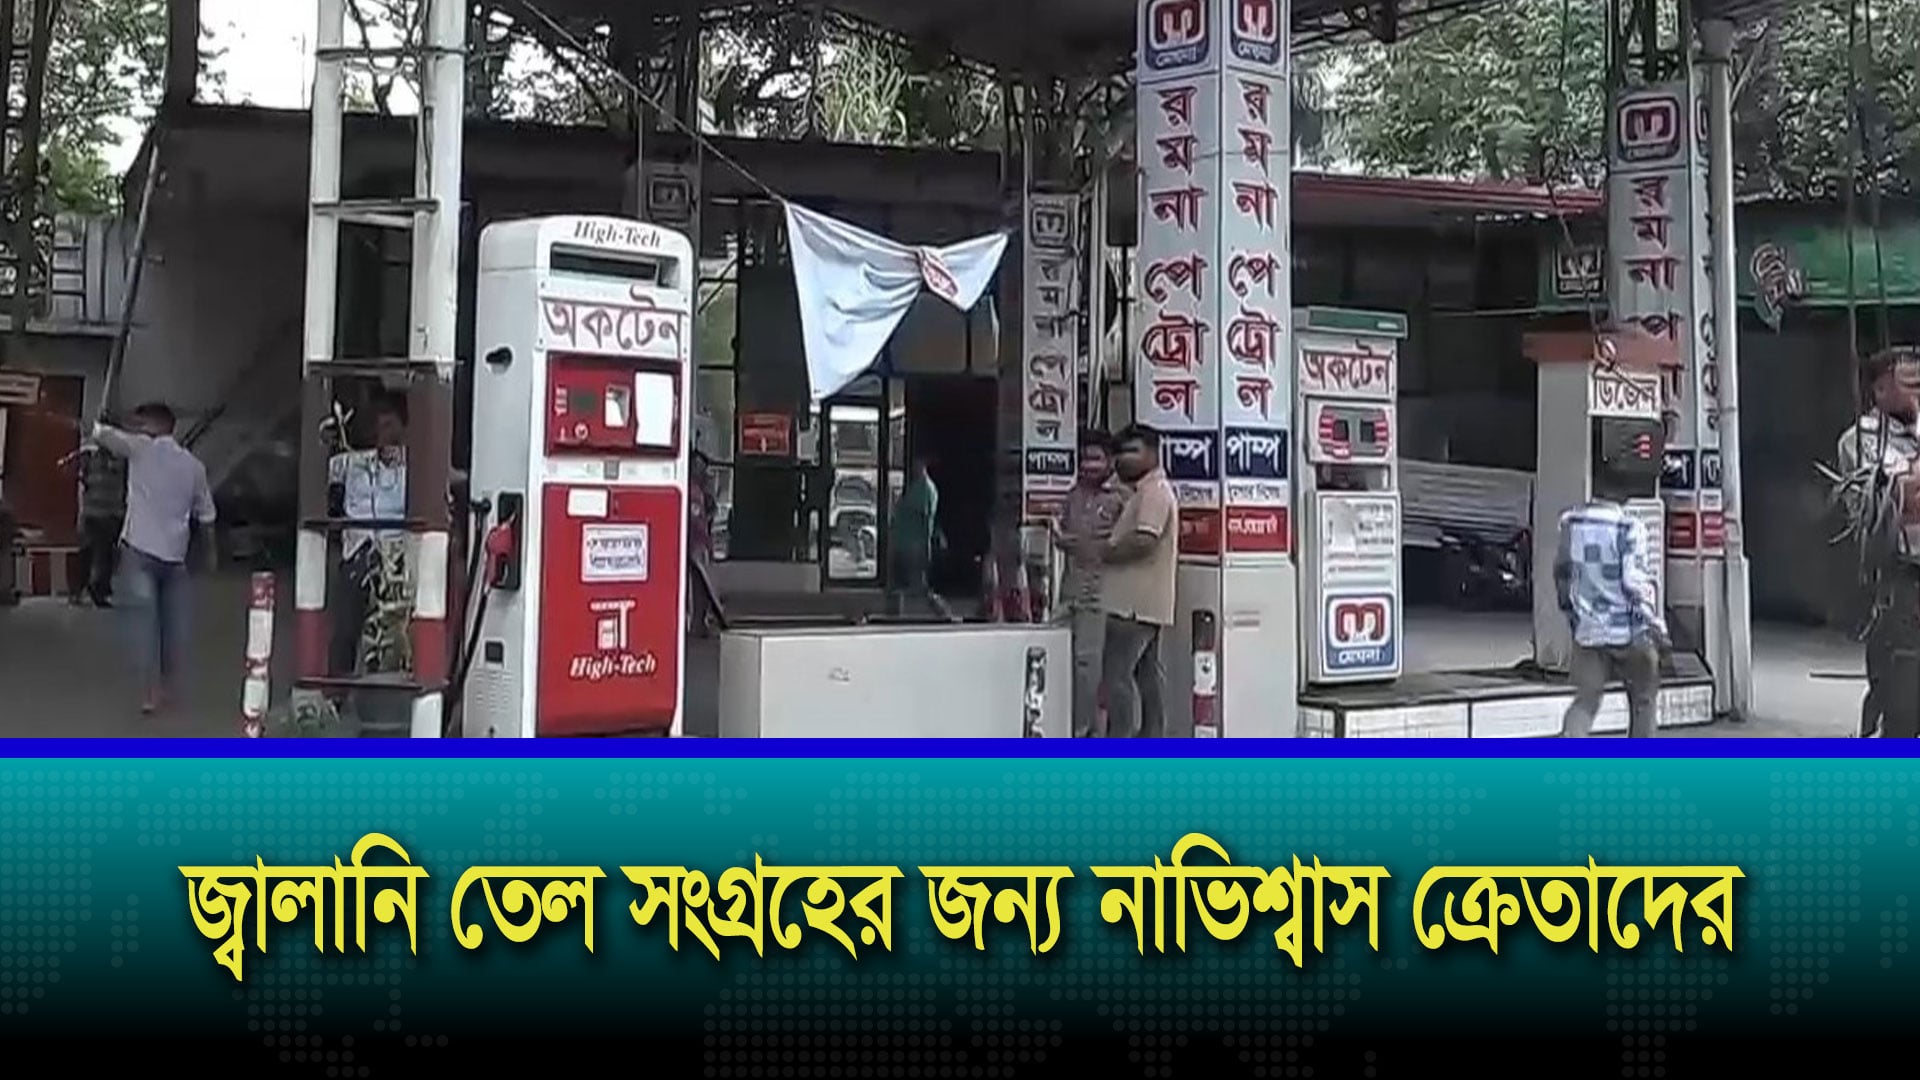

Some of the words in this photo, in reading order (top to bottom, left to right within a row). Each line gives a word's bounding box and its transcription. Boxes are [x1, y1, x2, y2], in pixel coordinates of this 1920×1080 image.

[1149, 84, 1207, 232] রমনা
[1232, 78, 1279, 232] রমনা
[573, 220, 662, 249] High-Tech
[540, 285, 689, 359] অকটেন
[1141, 253, 1209, 425] পেট্রোল
[1227, 253, 1281, 422] পেট্রোল
[1302, 339, 1392, 394] অকটেন
[1160, 430, 1213, 478] াম্প
[1226, 431, 1281, 474] পাম্প
[569, 654, 657, 681] High-Tech
